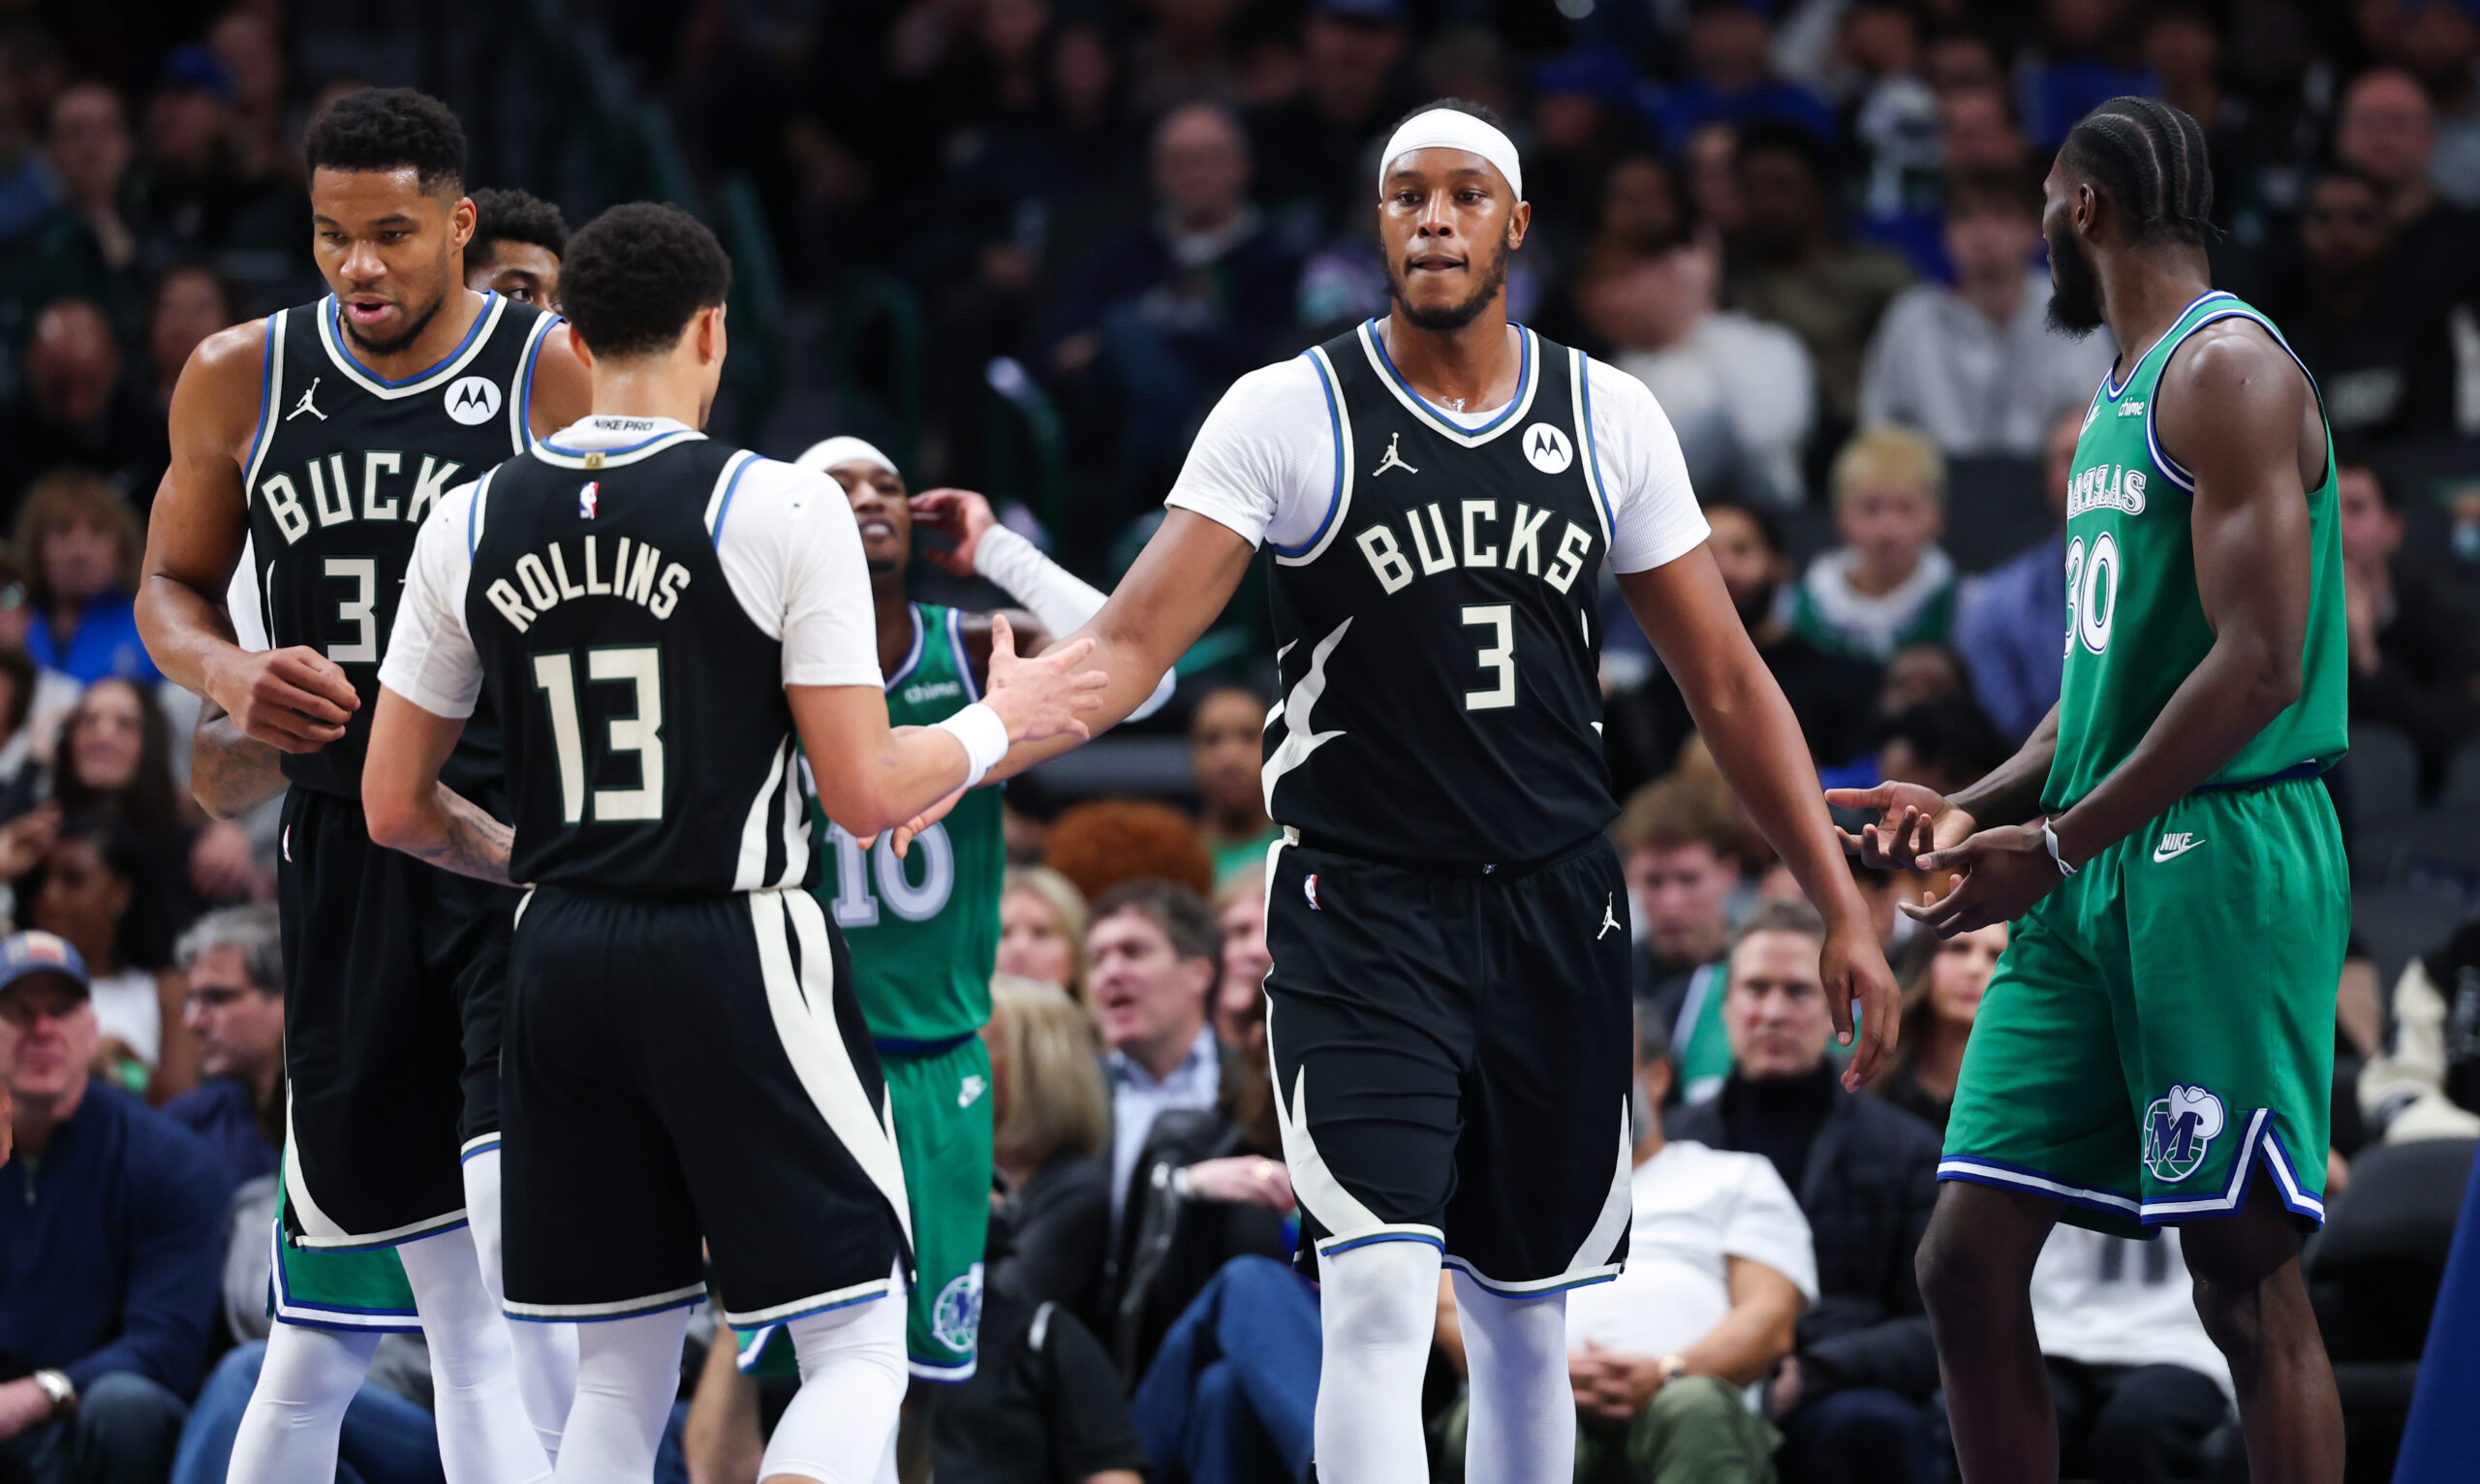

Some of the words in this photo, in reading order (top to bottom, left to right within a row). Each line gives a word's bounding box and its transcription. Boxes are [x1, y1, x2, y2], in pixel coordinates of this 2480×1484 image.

[593, 418, 622, 430] NIKE
[623, 419, 654, 431] PRO
[2118, 396, 2145, 417] chime
[261, 450, 485, 546] BUCK
[1356, 498, 1593, 596] BUCKS
[321, 555, 405, 665] 3
[485, 535, 691, 634] ROLLINS
[2063, 531, 2120, 660] 30
[1461, 602, 1518, 712] 3
[530, 643, 666, 826] 13
[825, 819, 954, 928] 10
[2159, 832, 2194, 850] NIKE
[2145, 1111, 2204, 1161] M
